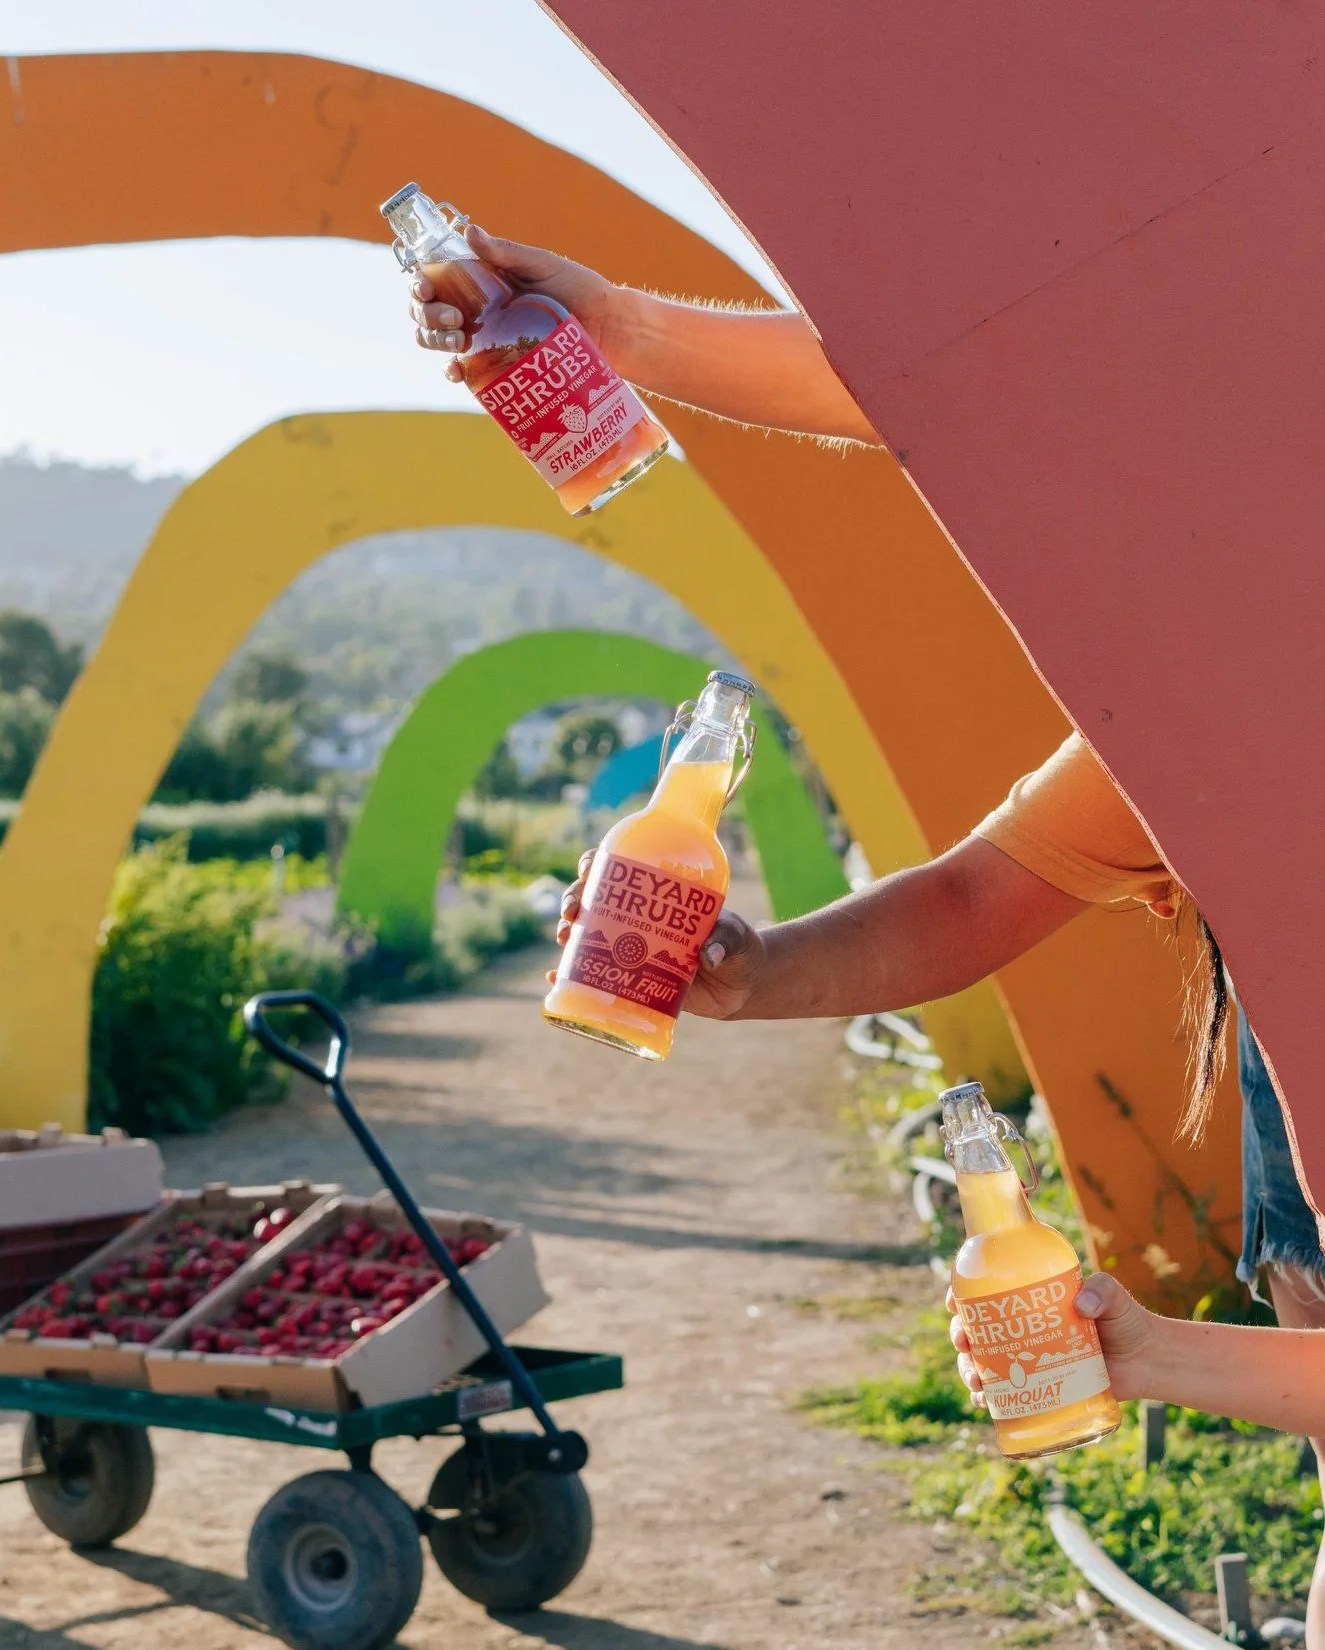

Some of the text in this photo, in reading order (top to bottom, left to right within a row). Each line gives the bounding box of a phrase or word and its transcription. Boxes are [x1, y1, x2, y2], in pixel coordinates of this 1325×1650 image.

[479, 323, 582, 411] SIDEYARD
[501, 345, 591, 425] SHRUBS
[517, 391, 569, 433] FRUIT-INFUSED
[568, 365, 597, 393] VINEGAR
[549, 402, 628, 474] STRAWBERRY
[594, 881, 701, 936] SHRUBS
[655, 927, 690, 947] VINEGAR
[574, 956, 636, 986] ASSION
[636, 978, 678, 1002] FRUIT
[964, 1306, 1063, 1345] SHRUBS
[1024, 1329, 1064, 1348] VINEGAR
[993, 1381, 1064, 1408] KUMQUAT
